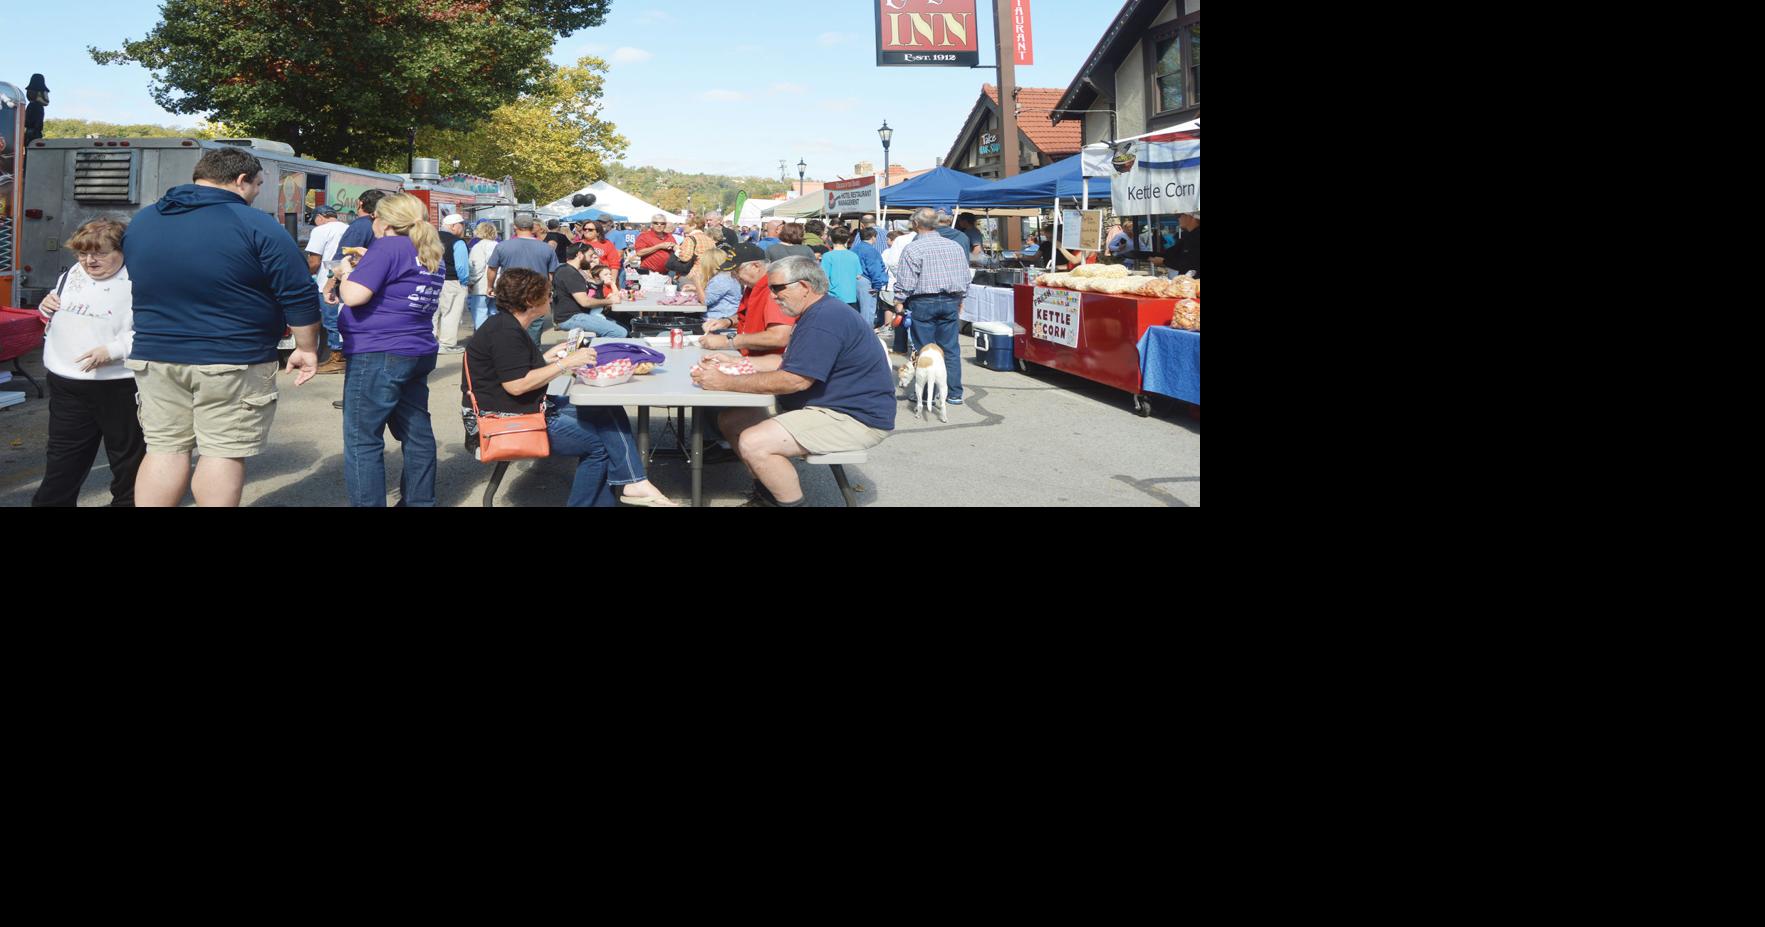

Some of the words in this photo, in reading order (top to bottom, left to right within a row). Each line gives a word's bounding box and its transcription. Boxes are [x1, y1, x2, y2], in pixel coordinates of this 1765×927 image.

[887, 12, 972, 47] INN
[1128, 184, 1161, 201] Kettle
[1165, 182, 1195, 198] Corn
[1036, 308, 1071, 326] KETTLE
[1042, 323, 1066, 339] CORN
